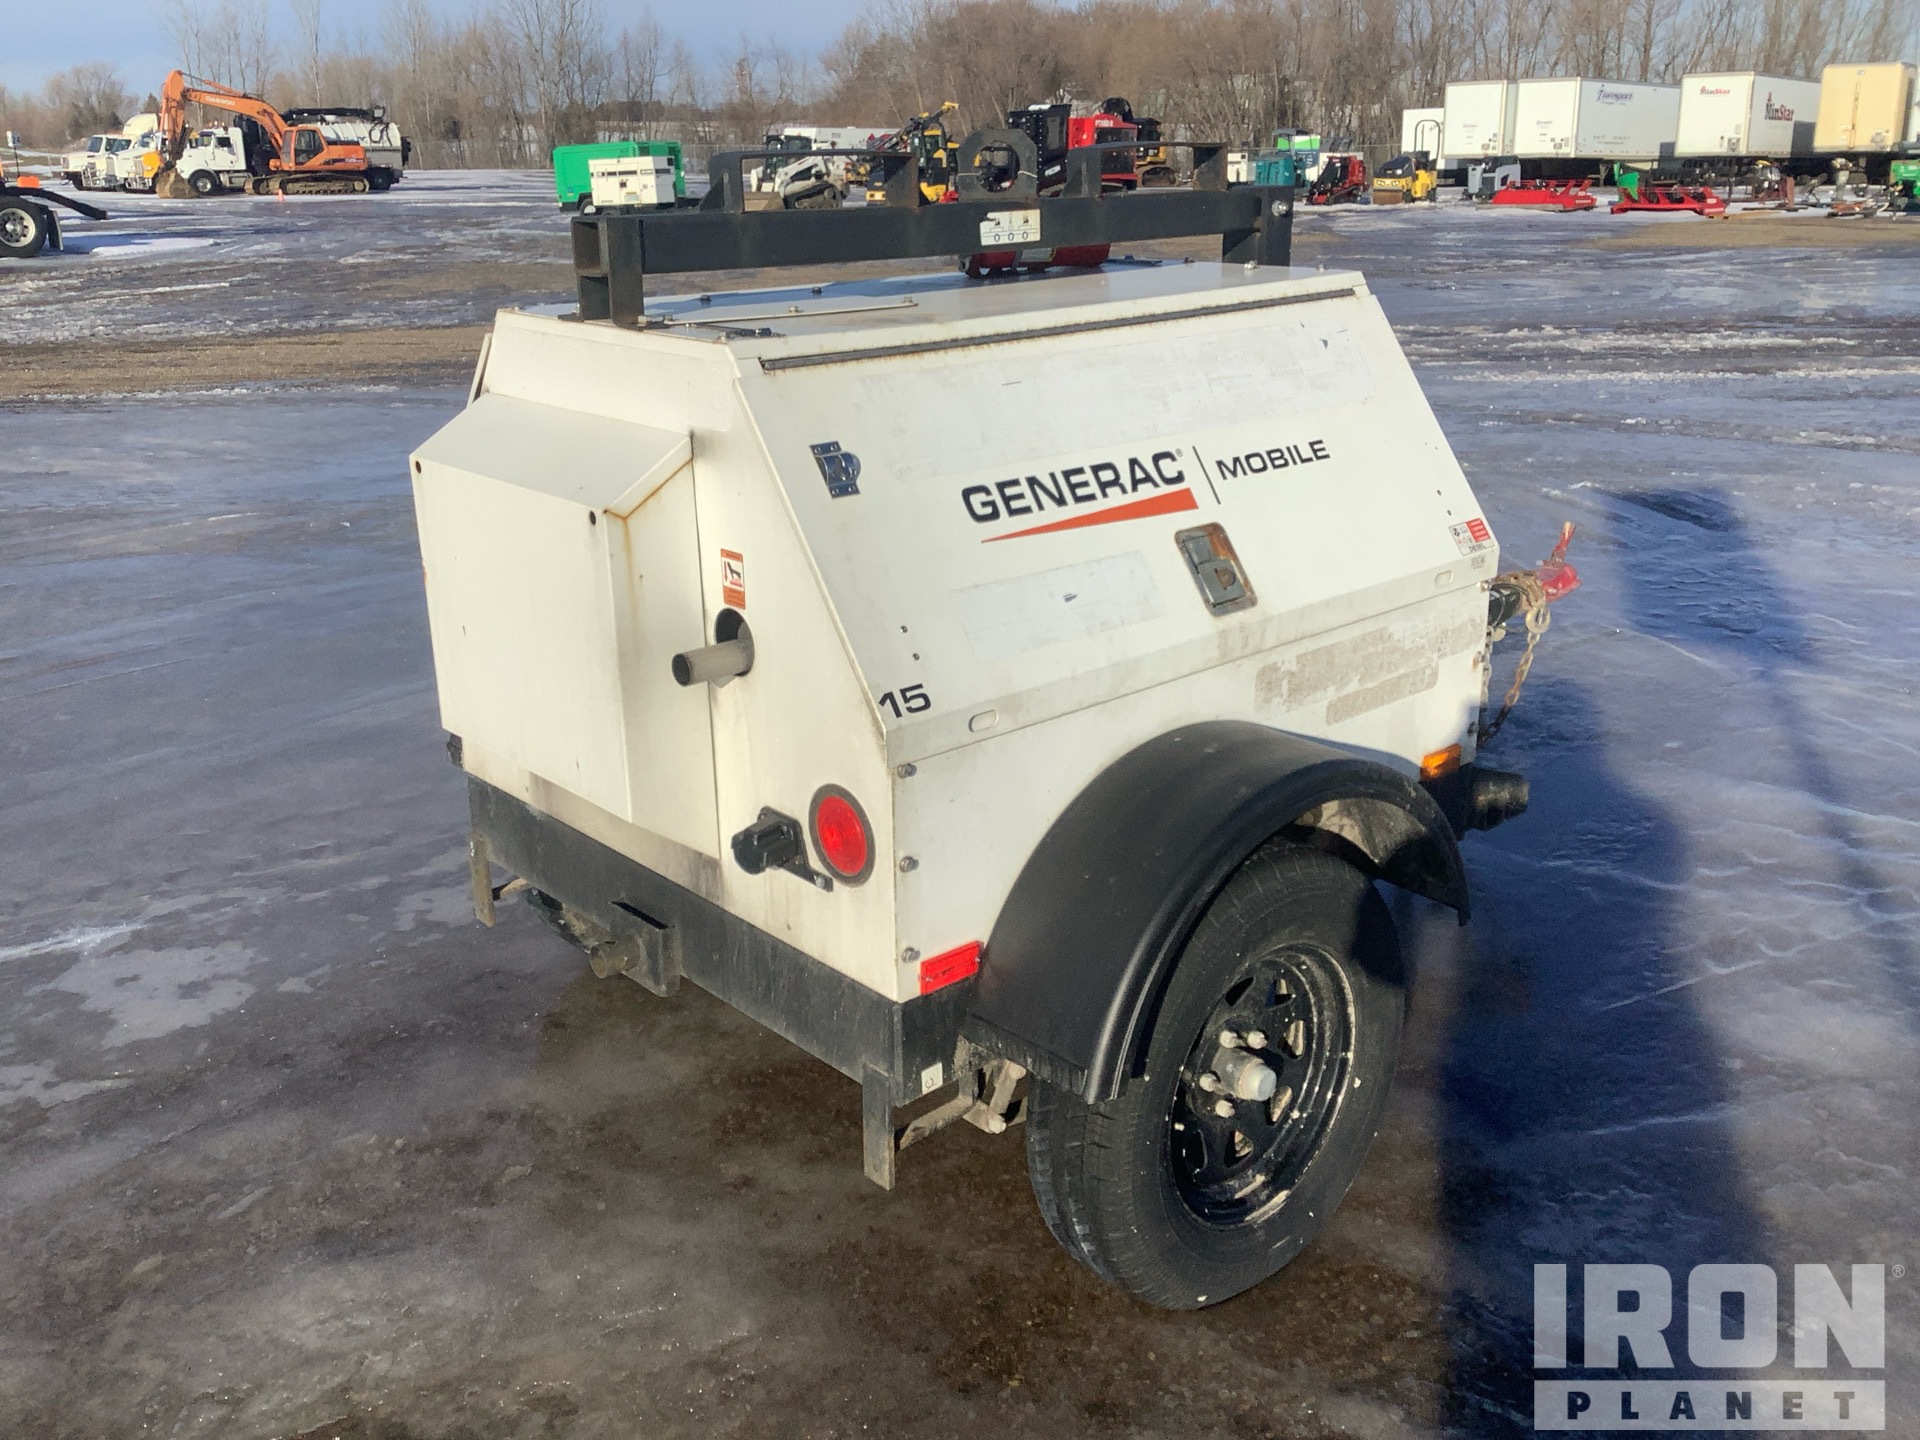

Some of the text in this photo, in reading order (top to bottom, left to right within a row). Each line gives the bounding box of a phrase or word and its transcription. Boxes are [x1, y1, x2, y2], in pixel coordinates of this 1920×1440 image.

[1597, 89, 1633, 101] Transport
[1764, 102, 1795, 121] MinStar
[961, 439, 1331, 524] GENERAC MOBILE
[878, 683, 932, 719] 15
